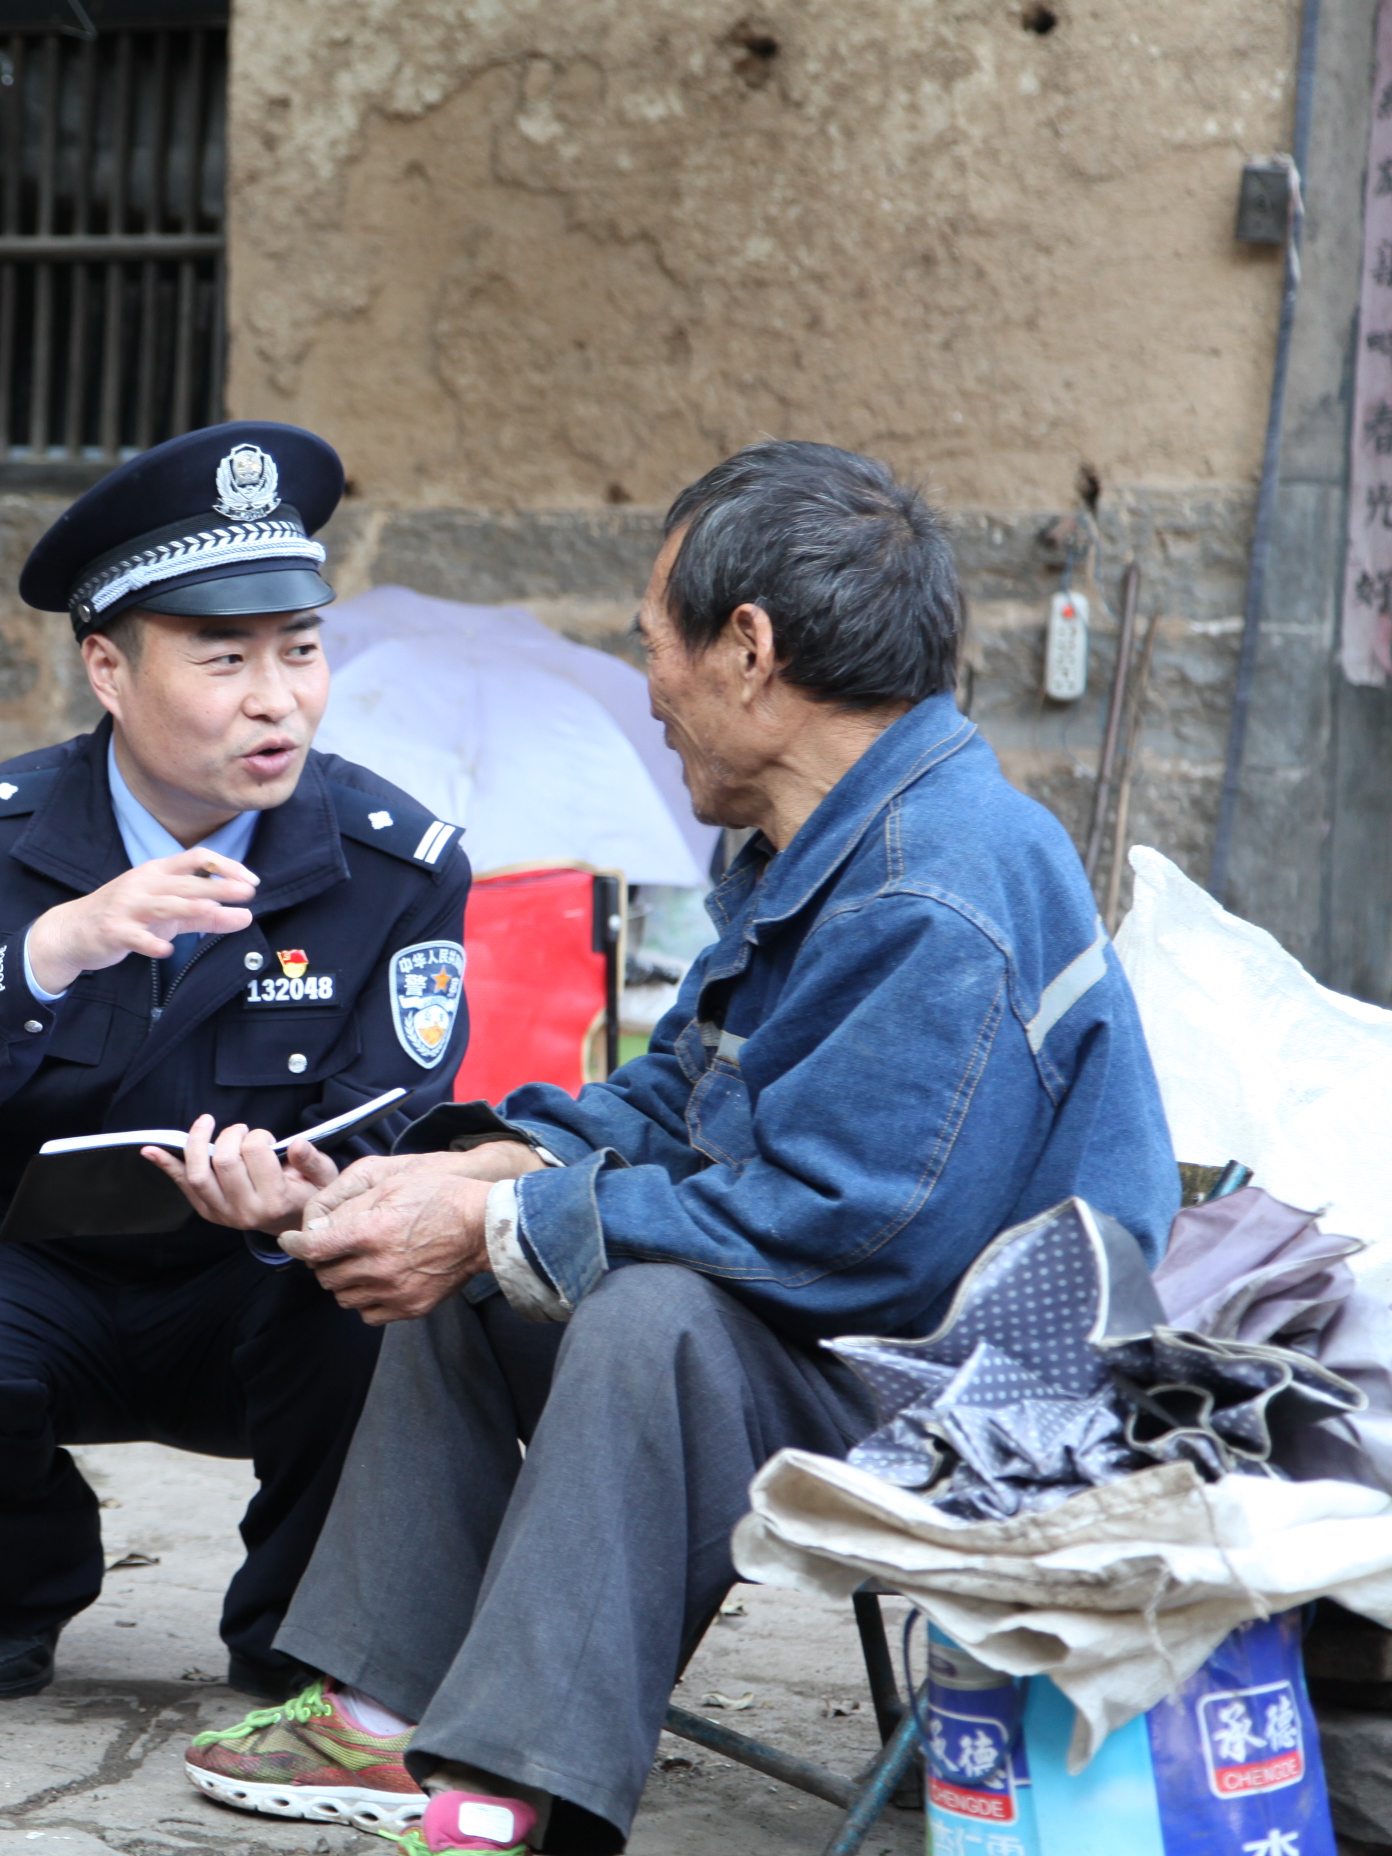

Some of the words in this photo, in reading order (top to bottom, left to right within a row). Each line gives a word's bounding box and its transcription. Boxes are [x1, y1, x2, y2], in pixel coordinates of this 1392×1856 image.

[398, 948, 462, 974] 中华人民共
[247, 976, 333, 1002] 132048
[1213, 1694, 1298, 1763] 承德
[1223, 1758, 1298, 1790] CHENGDE
